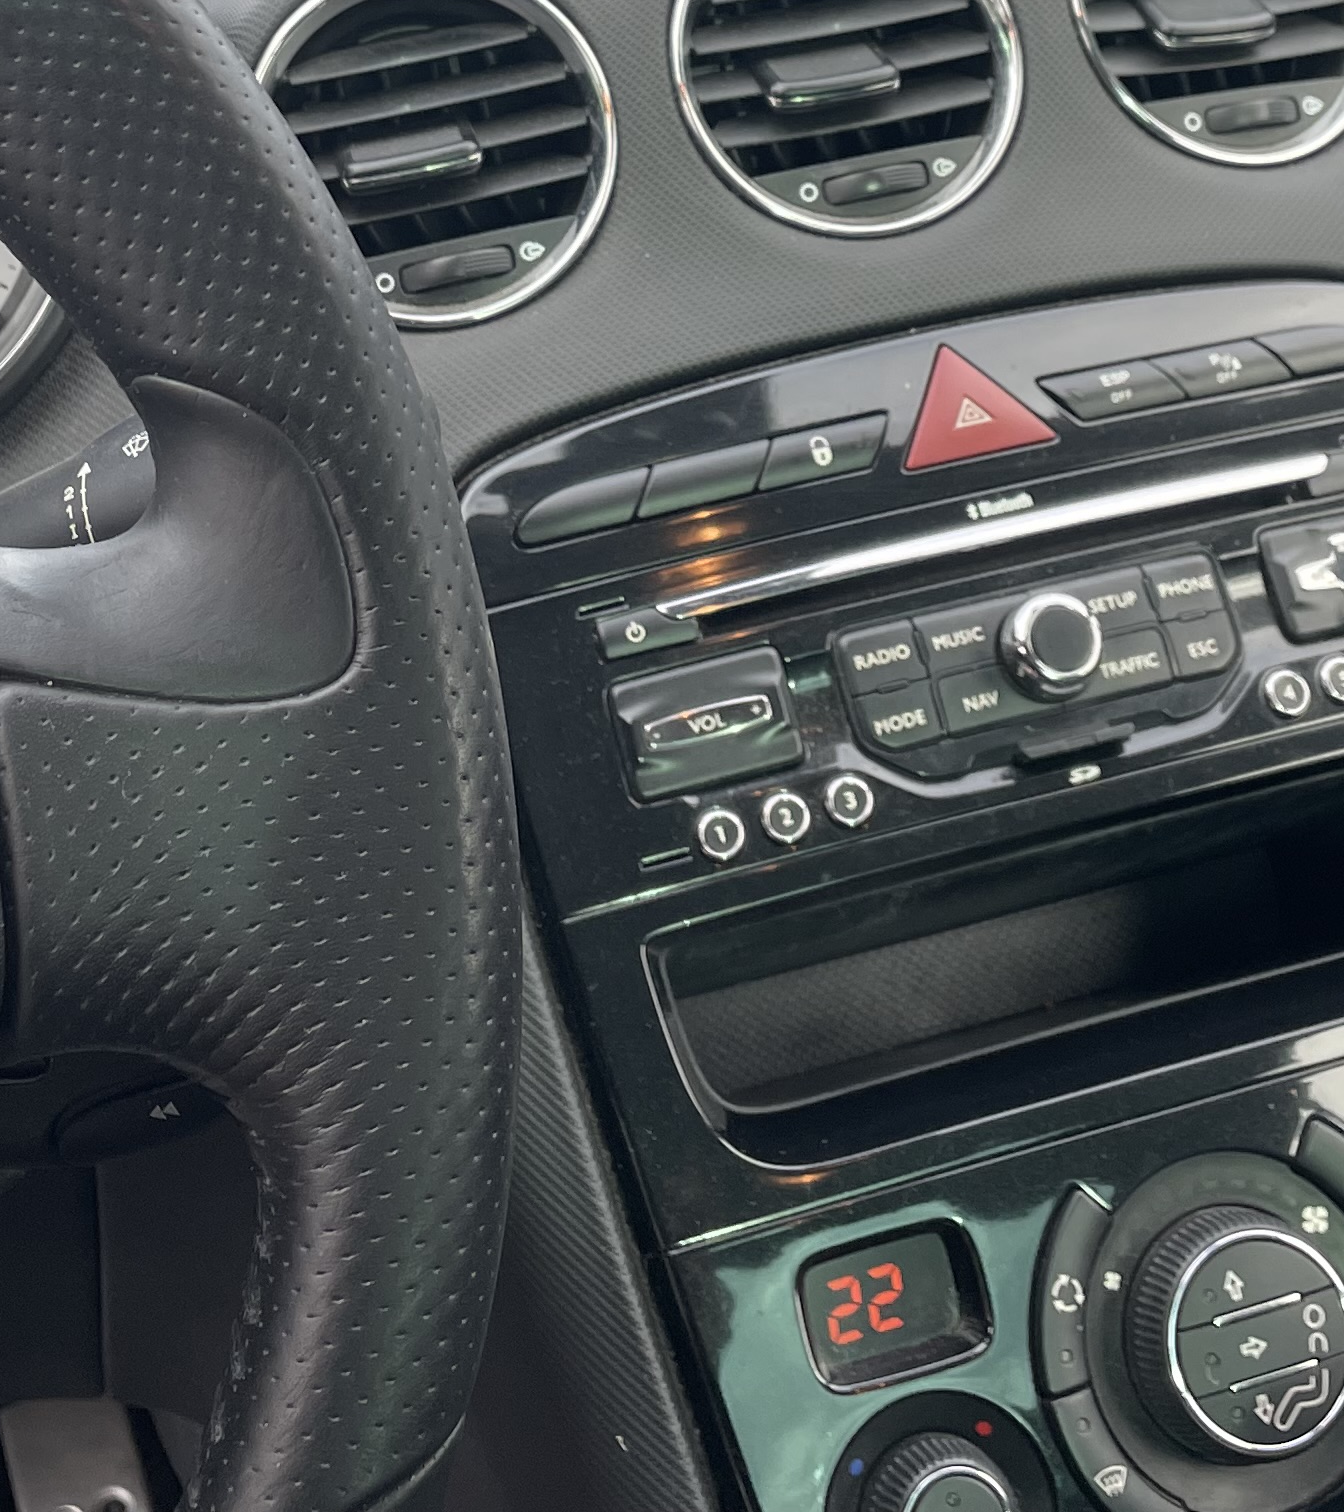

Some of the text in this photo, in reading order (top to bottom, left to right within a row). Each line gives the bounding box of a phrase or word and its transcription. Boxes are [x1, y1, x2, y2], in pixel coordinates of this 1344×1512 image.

[1157, 574, 1216, 600] PHONE
[1088, 590, 1139, 616] SETUP
[931, 625, 987, 652] MUSIC
[1186, 638, 1219, 661] ESC
[853, 643, 912, 672] RADIO
[1099, 651, 1161, 681] TRAFFIC
[961, 689, 1001, 714] NAV
[686, 712, 729, 735] VOL
[872, 708, 928, 737] MODE
[778, 807, 795, 828] 2
[842, 790, 858, 811] 3
[826, 1262, 905, 1346] 22
